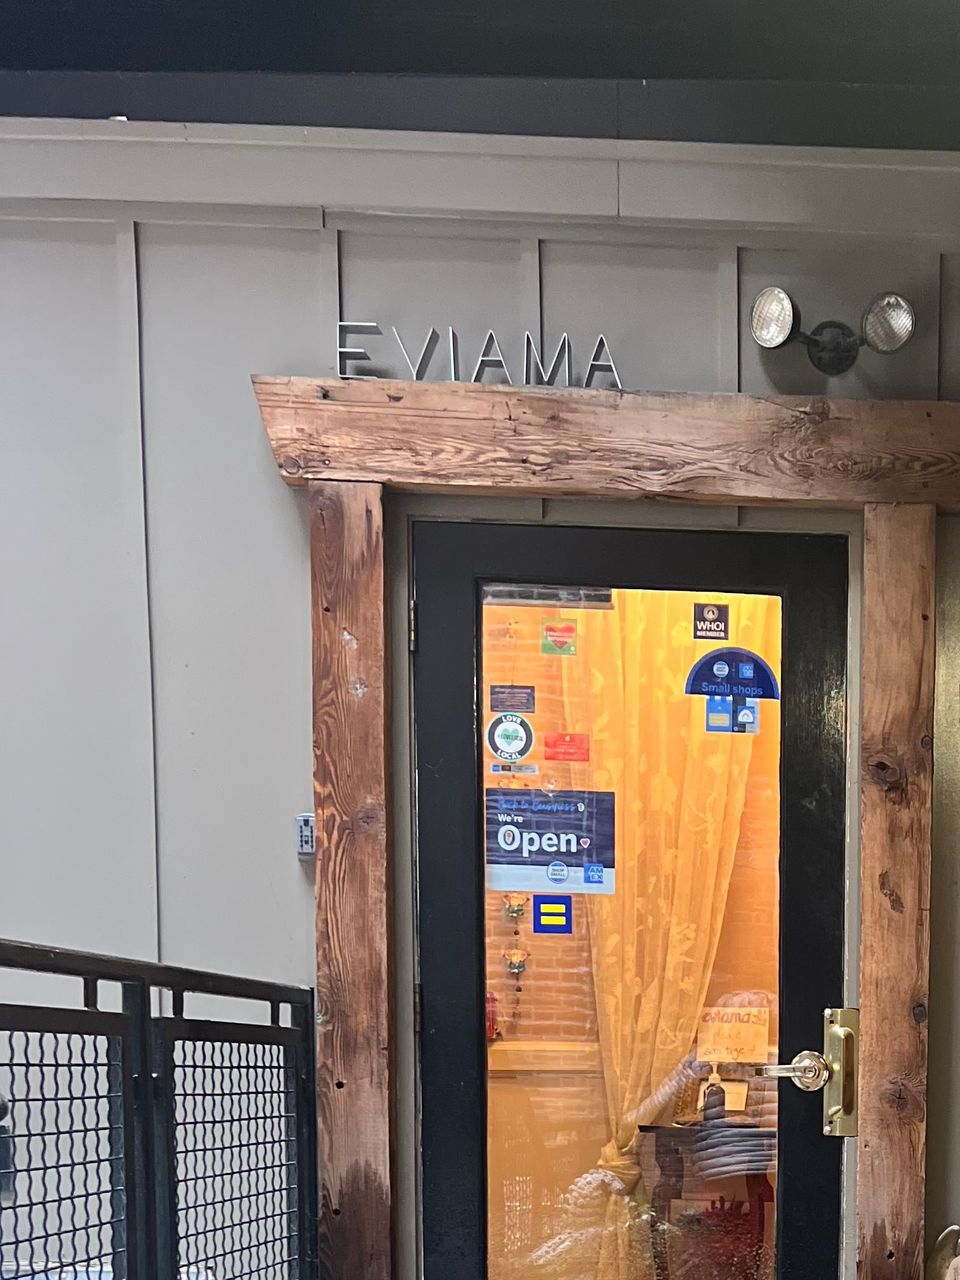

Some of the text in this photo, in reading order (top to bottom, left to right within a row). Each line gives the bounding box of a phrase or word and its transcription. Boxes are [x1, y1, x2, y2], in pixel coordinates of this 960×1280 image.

[337, 321, 624, 390] EVIAMA
[696, 621, 725, 631] WHOI
[701, 682, 764, 697] Small shops
[501, 715, 522, 725] LOVE
[497, 750, 522, 760] LOCAL
[498, 813, 524, 823] We're
[497, 824, 578, 858] Open
